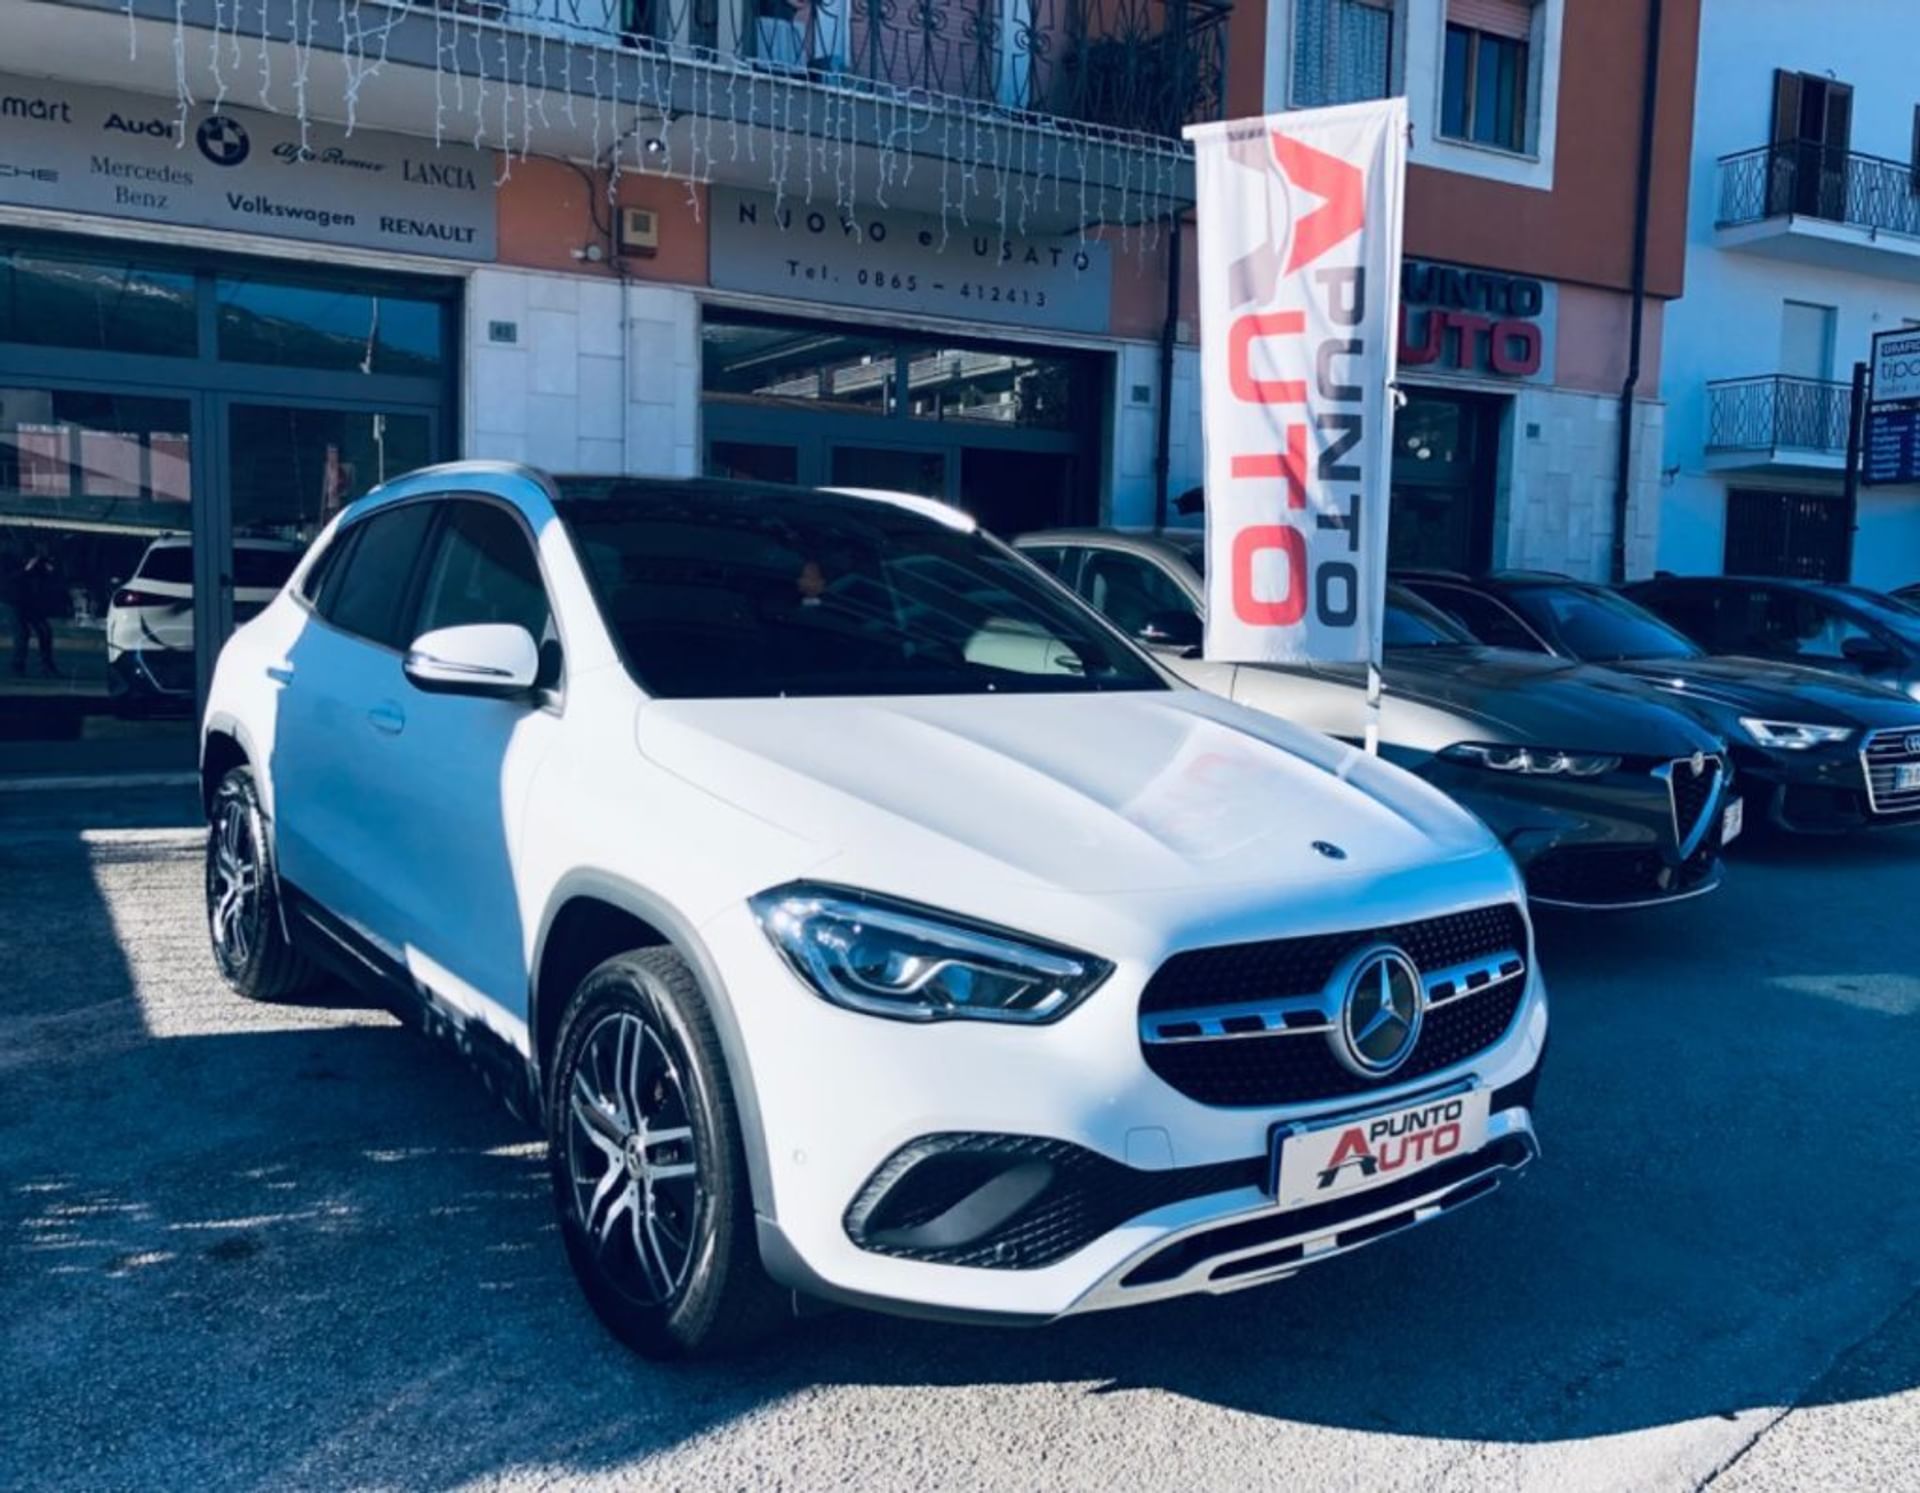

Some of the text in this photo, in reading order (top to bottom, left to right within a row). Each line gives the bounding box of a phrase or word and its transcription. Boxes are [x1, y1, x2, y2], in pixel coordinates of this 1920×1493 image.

[103, 113, 174, 139] Audi
[90, 155, 194, 186] Mercedes
[403, 159, 477, 191] LANCIA
[115, 185, 170, 210] Benz
[227, 191, 356, 227] Volkswagen
[379, 215, 478, 244] RENAULT
[917, 231, 933, 247] e
[973, 236, 1090, 272] USATO
[786, 259, 839, 283] Tel.
[857, 268, 917, 292] 0865
[960, 282, 1047, 308] 412413
[1227, 127, 1365, 628] AUTO
[1315, 265, 1366, 629] PUNTO
[1369, 1099, 1463, 1142] PUNTO
[1316, 1123, 1461, 1190] AUTO
